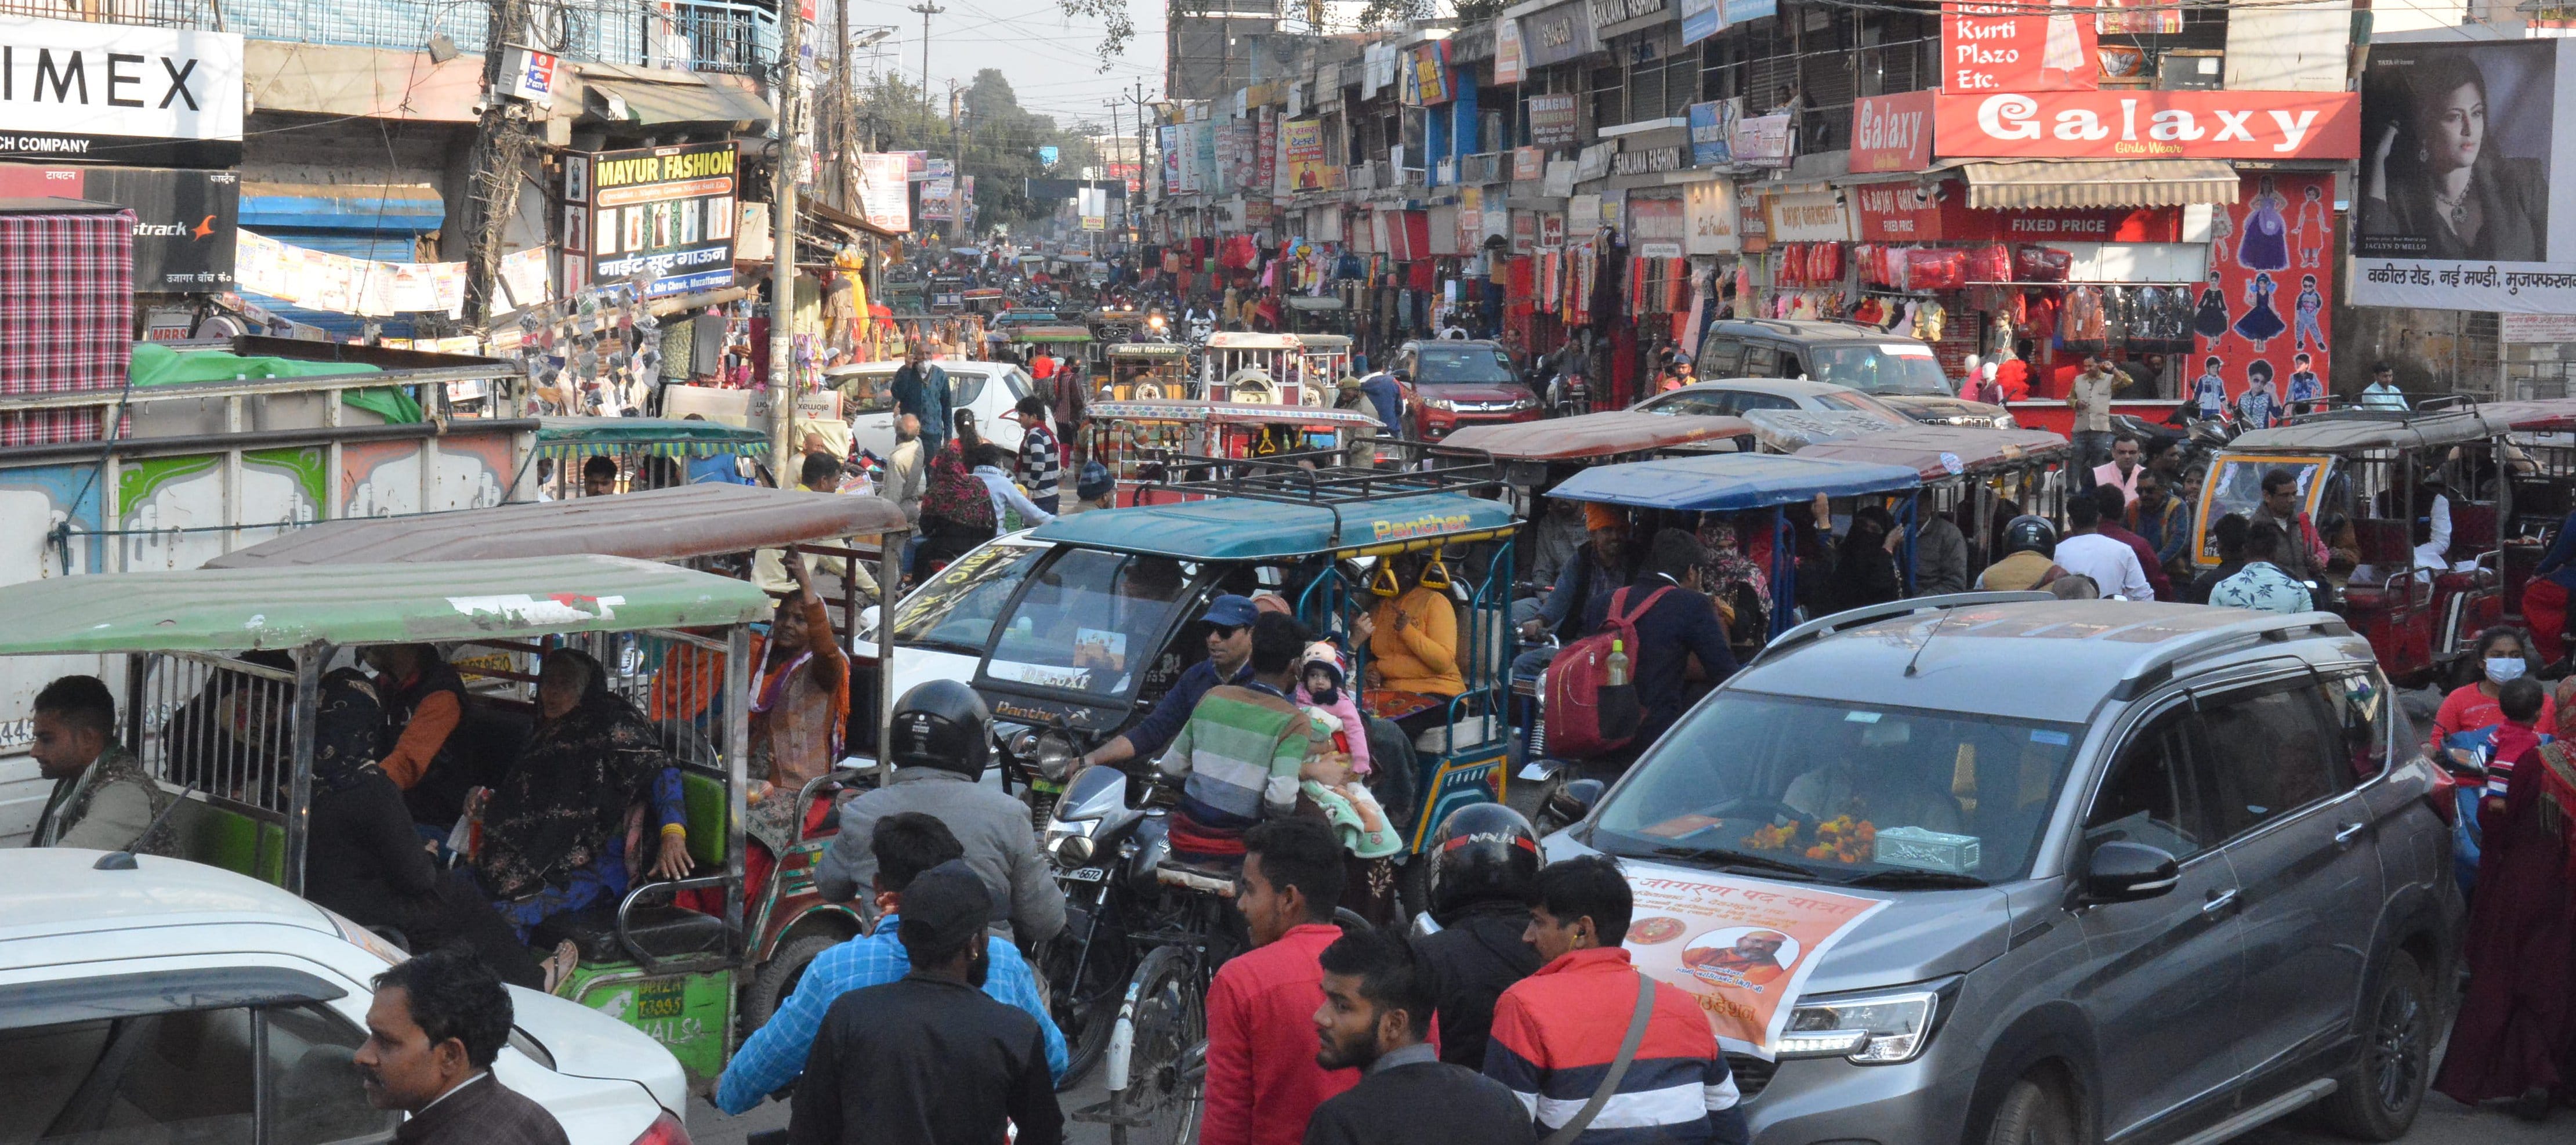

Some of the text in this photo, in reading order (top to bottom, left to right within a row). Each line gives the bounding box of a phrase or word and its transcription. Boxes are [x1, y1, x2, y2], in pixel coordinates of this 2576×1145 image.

[1956, 20, 2016, 39] Kurti
[1956, 43, 2019, 64] Plazo
[1957, 70, 2000, 88] Etc.
[1532, 97, 1573, 111] SHAGUN
[1860, 100, 1922, 159] Galaxy
[1977, 93, 2319, 152] Galaxy
[19, 137, 89, 153] COMPANY
[2115, 141, 2183, 153] Girls Wear
[46, 171, 76, 180] टायटन
[597, 150, 734, 187] MAYUR FASHION
[1802, 205, 1838, 227] GARMENTS
[1884, 219, 1914, 232] FIXED PRICE
[2012, 219, 2106, 232] FIXED PRICE
[166, 273, 194, 283] उजागर
[198, 271, 214, 282] वॉच
[690, 276, 732, 288] Muzaffarnagar
[2368, 263, 2407, 284] वकील
[2410, 265, 2434, 286] रोड,
[2440, 265, 2461, 287] नई
[2465, 266, 2500, 288] मण्डी,
[1118, 345, 1177, 354] Mini Metro
[798, 403, 829, 412] alomax
[1372, 513, 1471, 541] Panther
[1640, 878, 1739, 897] जागरण
